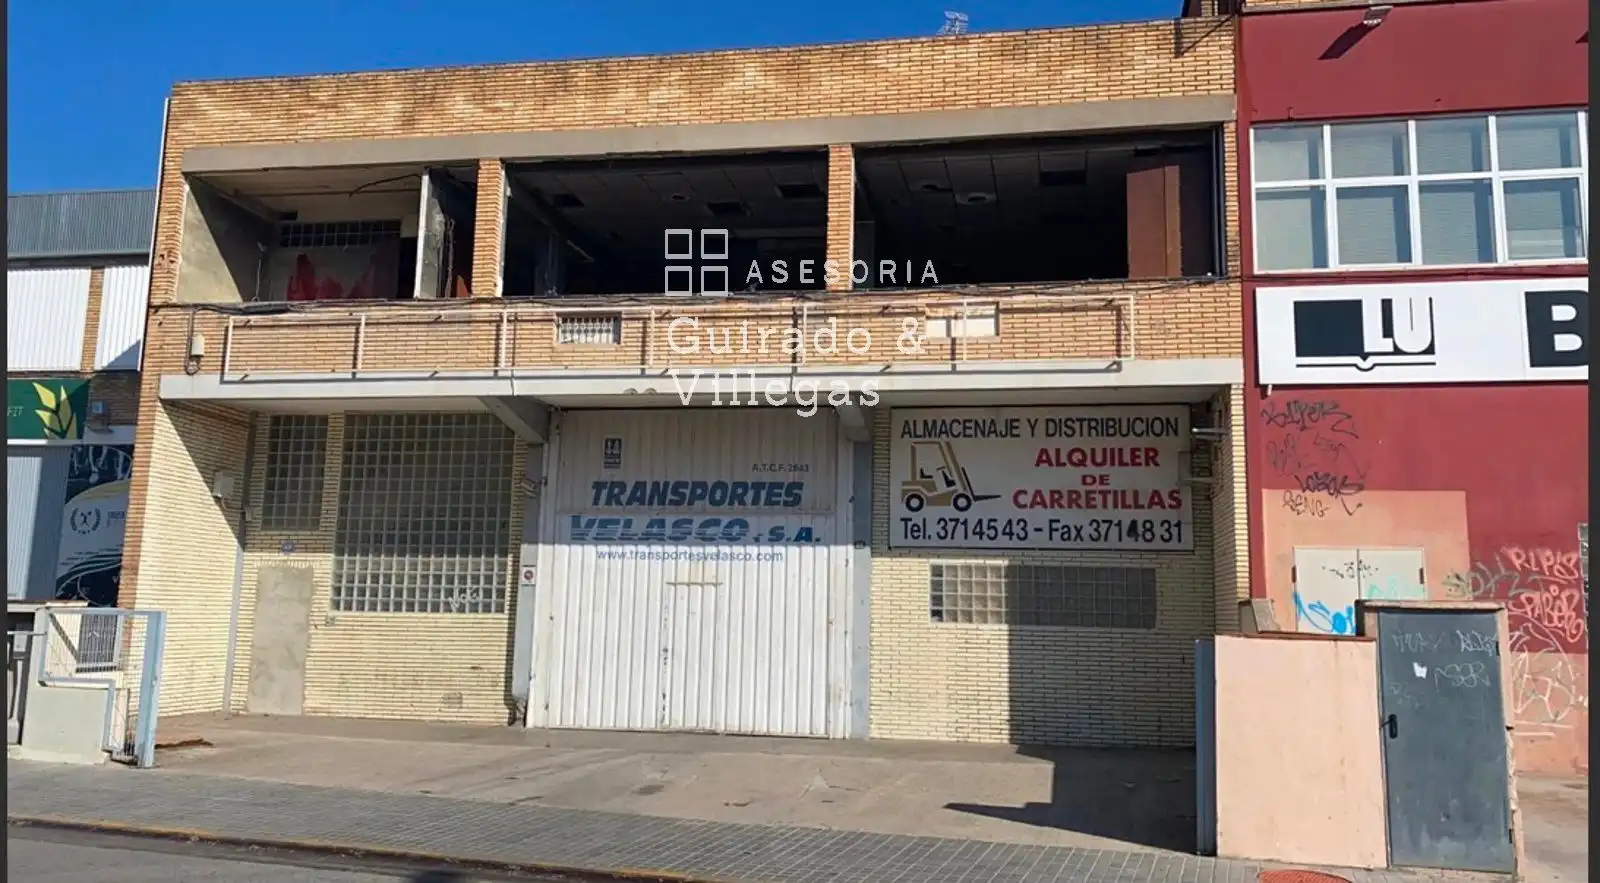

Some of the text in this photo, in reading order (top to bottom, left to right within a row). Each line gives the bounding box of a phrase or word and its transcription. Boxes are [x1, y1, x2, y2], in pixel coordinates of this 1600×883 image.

[901, 416, 1179, 438] ALMACENAJE Y DISTRIBUCION
[1035, 447, 1160, 467] ALQUILER
[1081, 474, 1111, 486] DE
[592, 480, 804, 507] TRANSPORTES
[1012, 489, 1183, 510] CARRETILLAS
[767, 525, 821, 543] S.A.
[900, 517, 932, 541] Tel.
[1049, 519, 1085, 542] Fax
[597, 550, 784, 563] www.transportesvelasco.com
